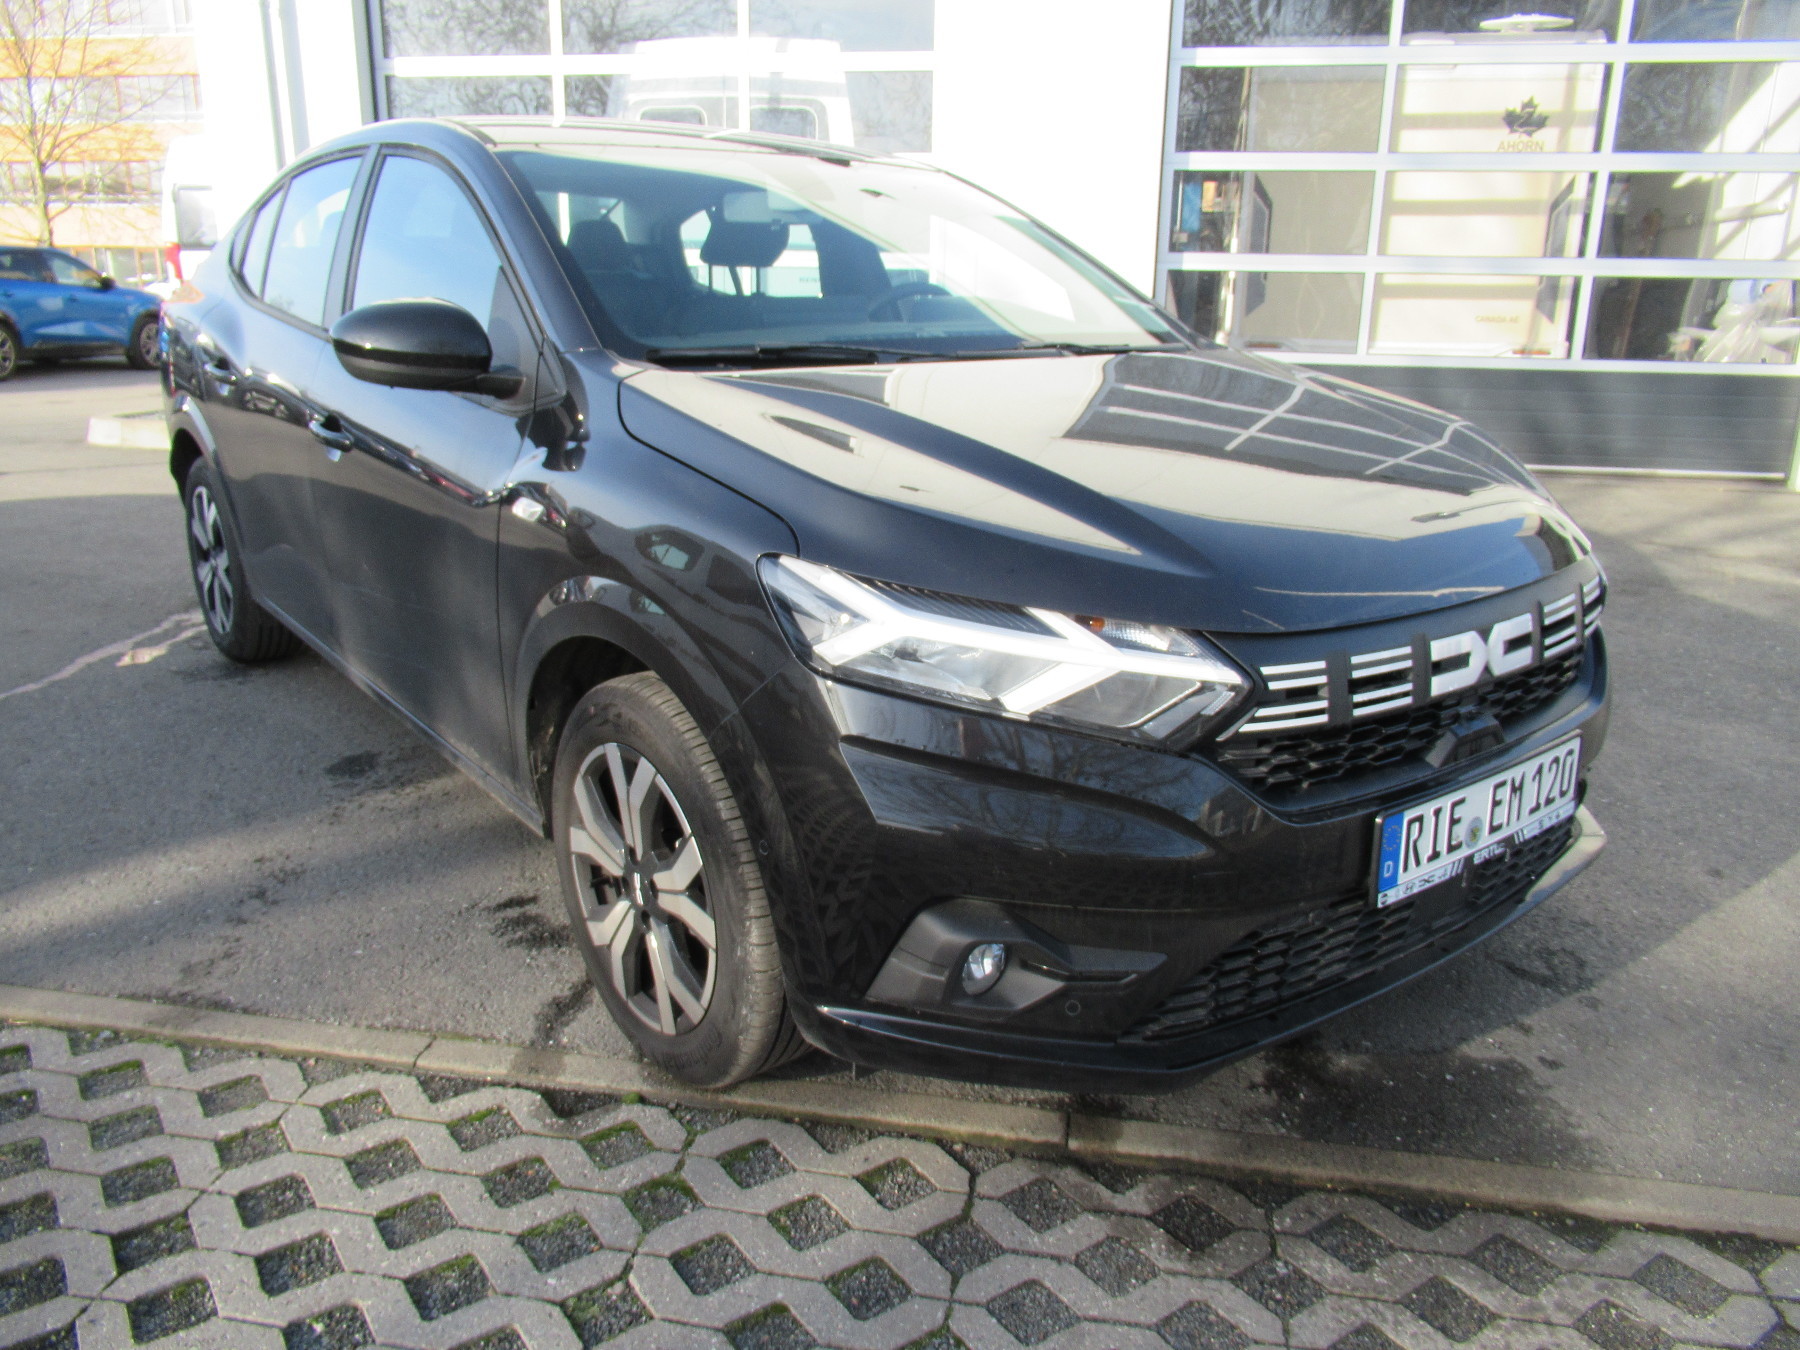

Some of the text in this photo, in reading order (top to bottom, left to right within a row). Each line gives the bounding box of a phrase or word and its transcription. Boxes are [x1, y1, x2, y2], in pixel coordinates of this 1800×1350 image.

[1496, 140, 1545, 152] AHORN
[1402, 748, 1575, 874] RIE EM 120
[1383, 861, 1394, 878] D
